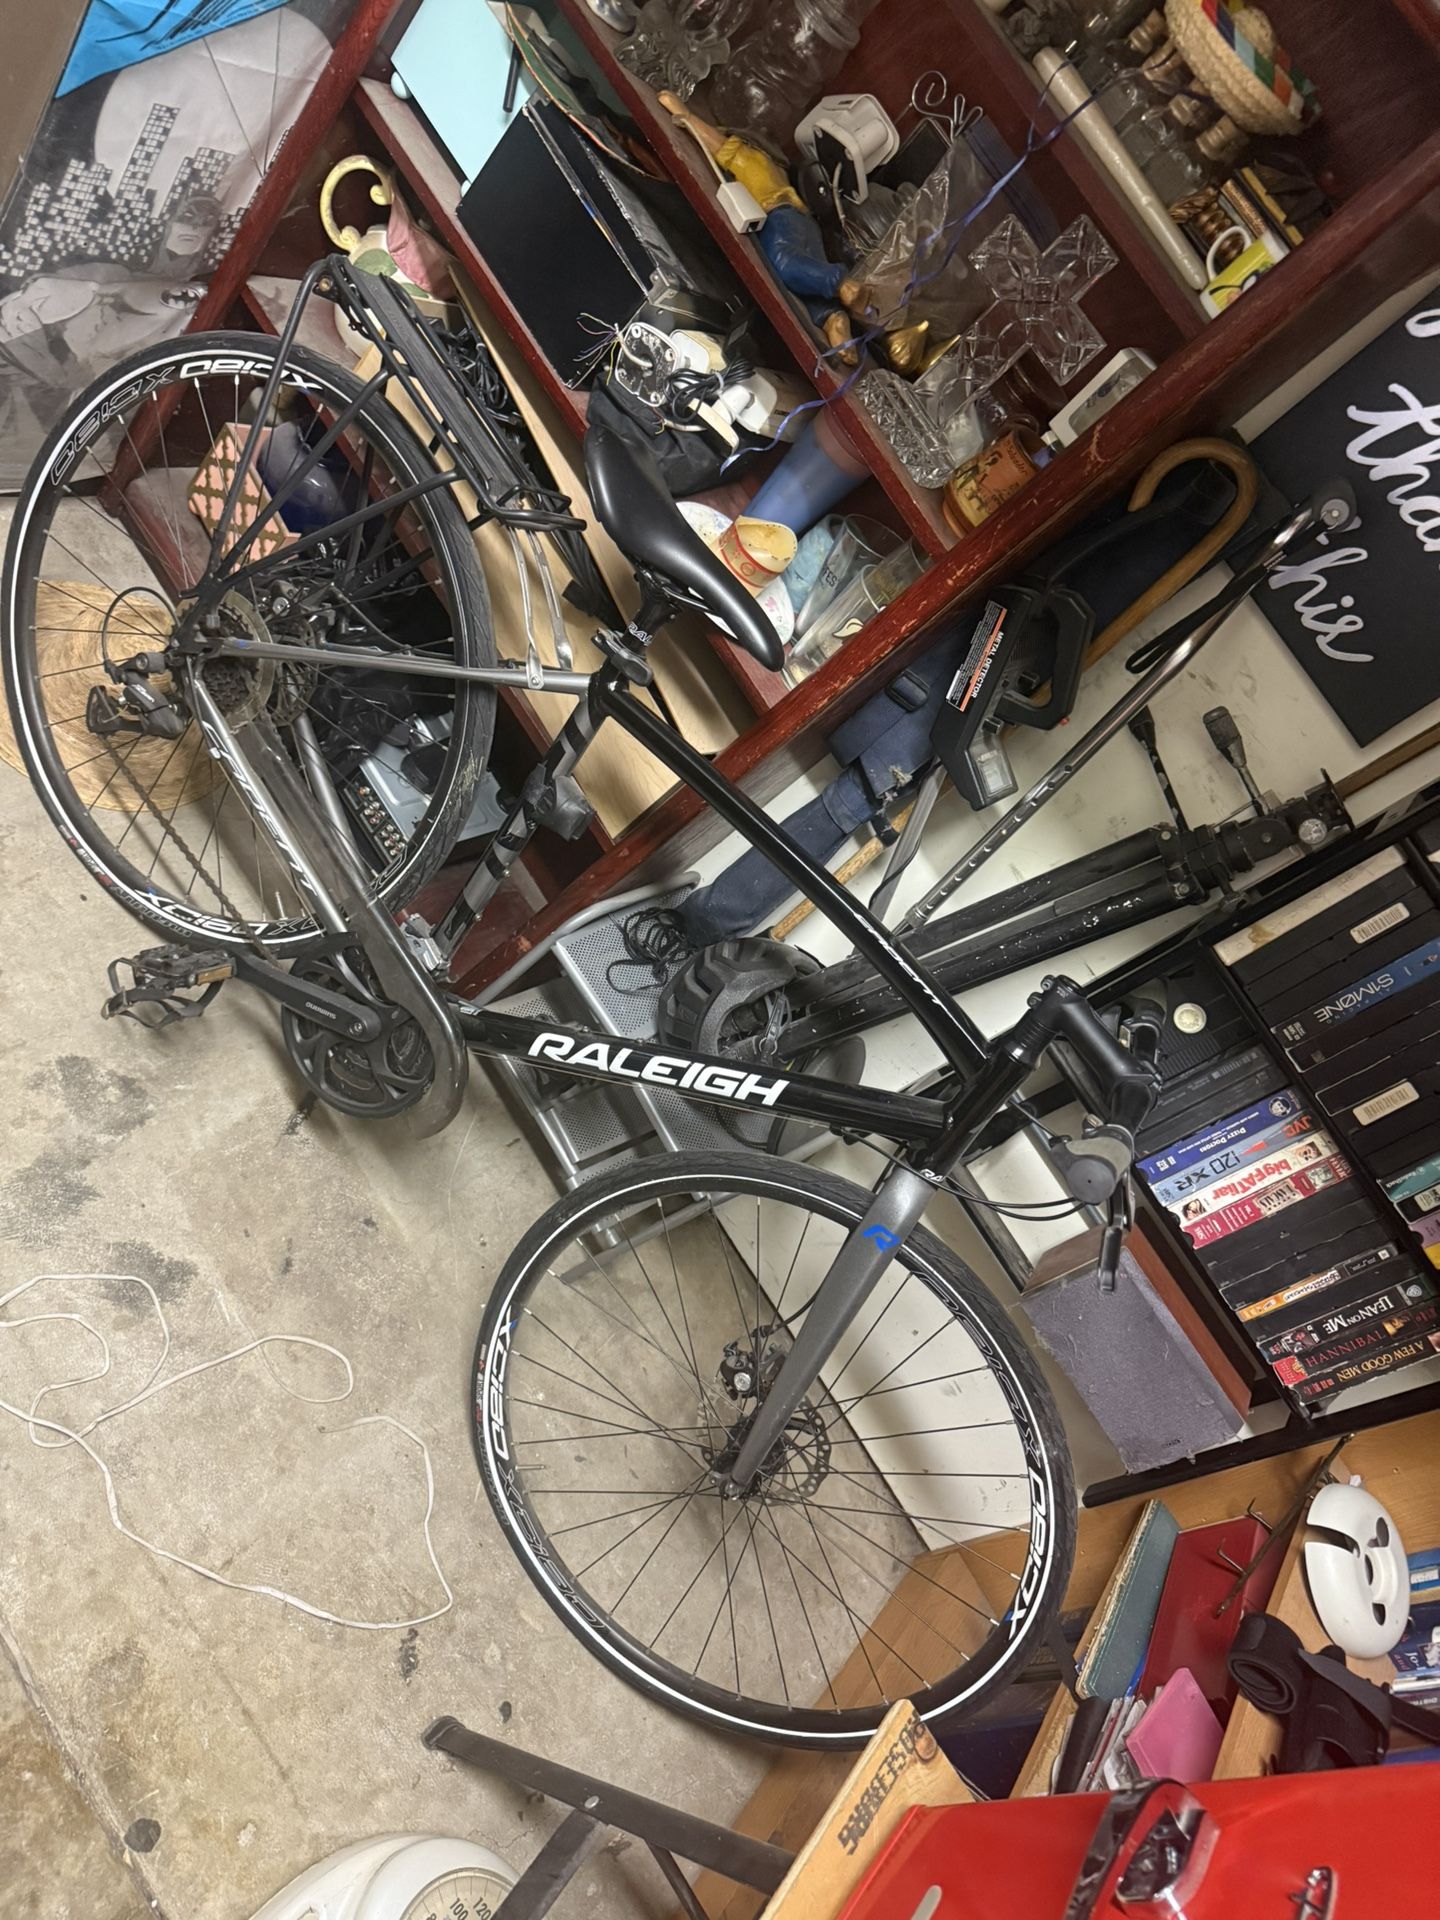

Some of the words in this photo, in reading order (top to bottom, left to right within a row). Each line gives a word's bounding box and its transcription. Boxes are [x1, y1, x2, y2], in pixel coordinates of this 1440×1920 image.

[1271, 521, 1374, 658] his
[989, 631, 1004, 656] METAL
[970, 657, 992, 698] DETECTOR
[527, 1032, 790, 1106] RALEIGH
[1280, 1114, 1314, 1139] JVC
[1174, 1167, 1210, 1192] XR
[1235, 1167, 1267, 1196] FAT
[1263, 1159, 1291, 1180] big
[1211, 1182, 1238, 1204] liar
[1346, 1313, 1361, 1326] ON
[1358, 1295, 1394, 1320] LEAN
[1322, 1314, 1348, 1335] ME
[1305, 1329, 1383, 1368] HANNIBAL
[1392, 1344, 1415, 1361] FEW
[1414, 1341, 1425, 1352] A
[1336, 1364, 1361, 1383] MEN
[1360, 1352, 1394, 1374] GOOD
[449, 1897, 468, 1920] 100
[472, 1897, 491, 1920] 120
